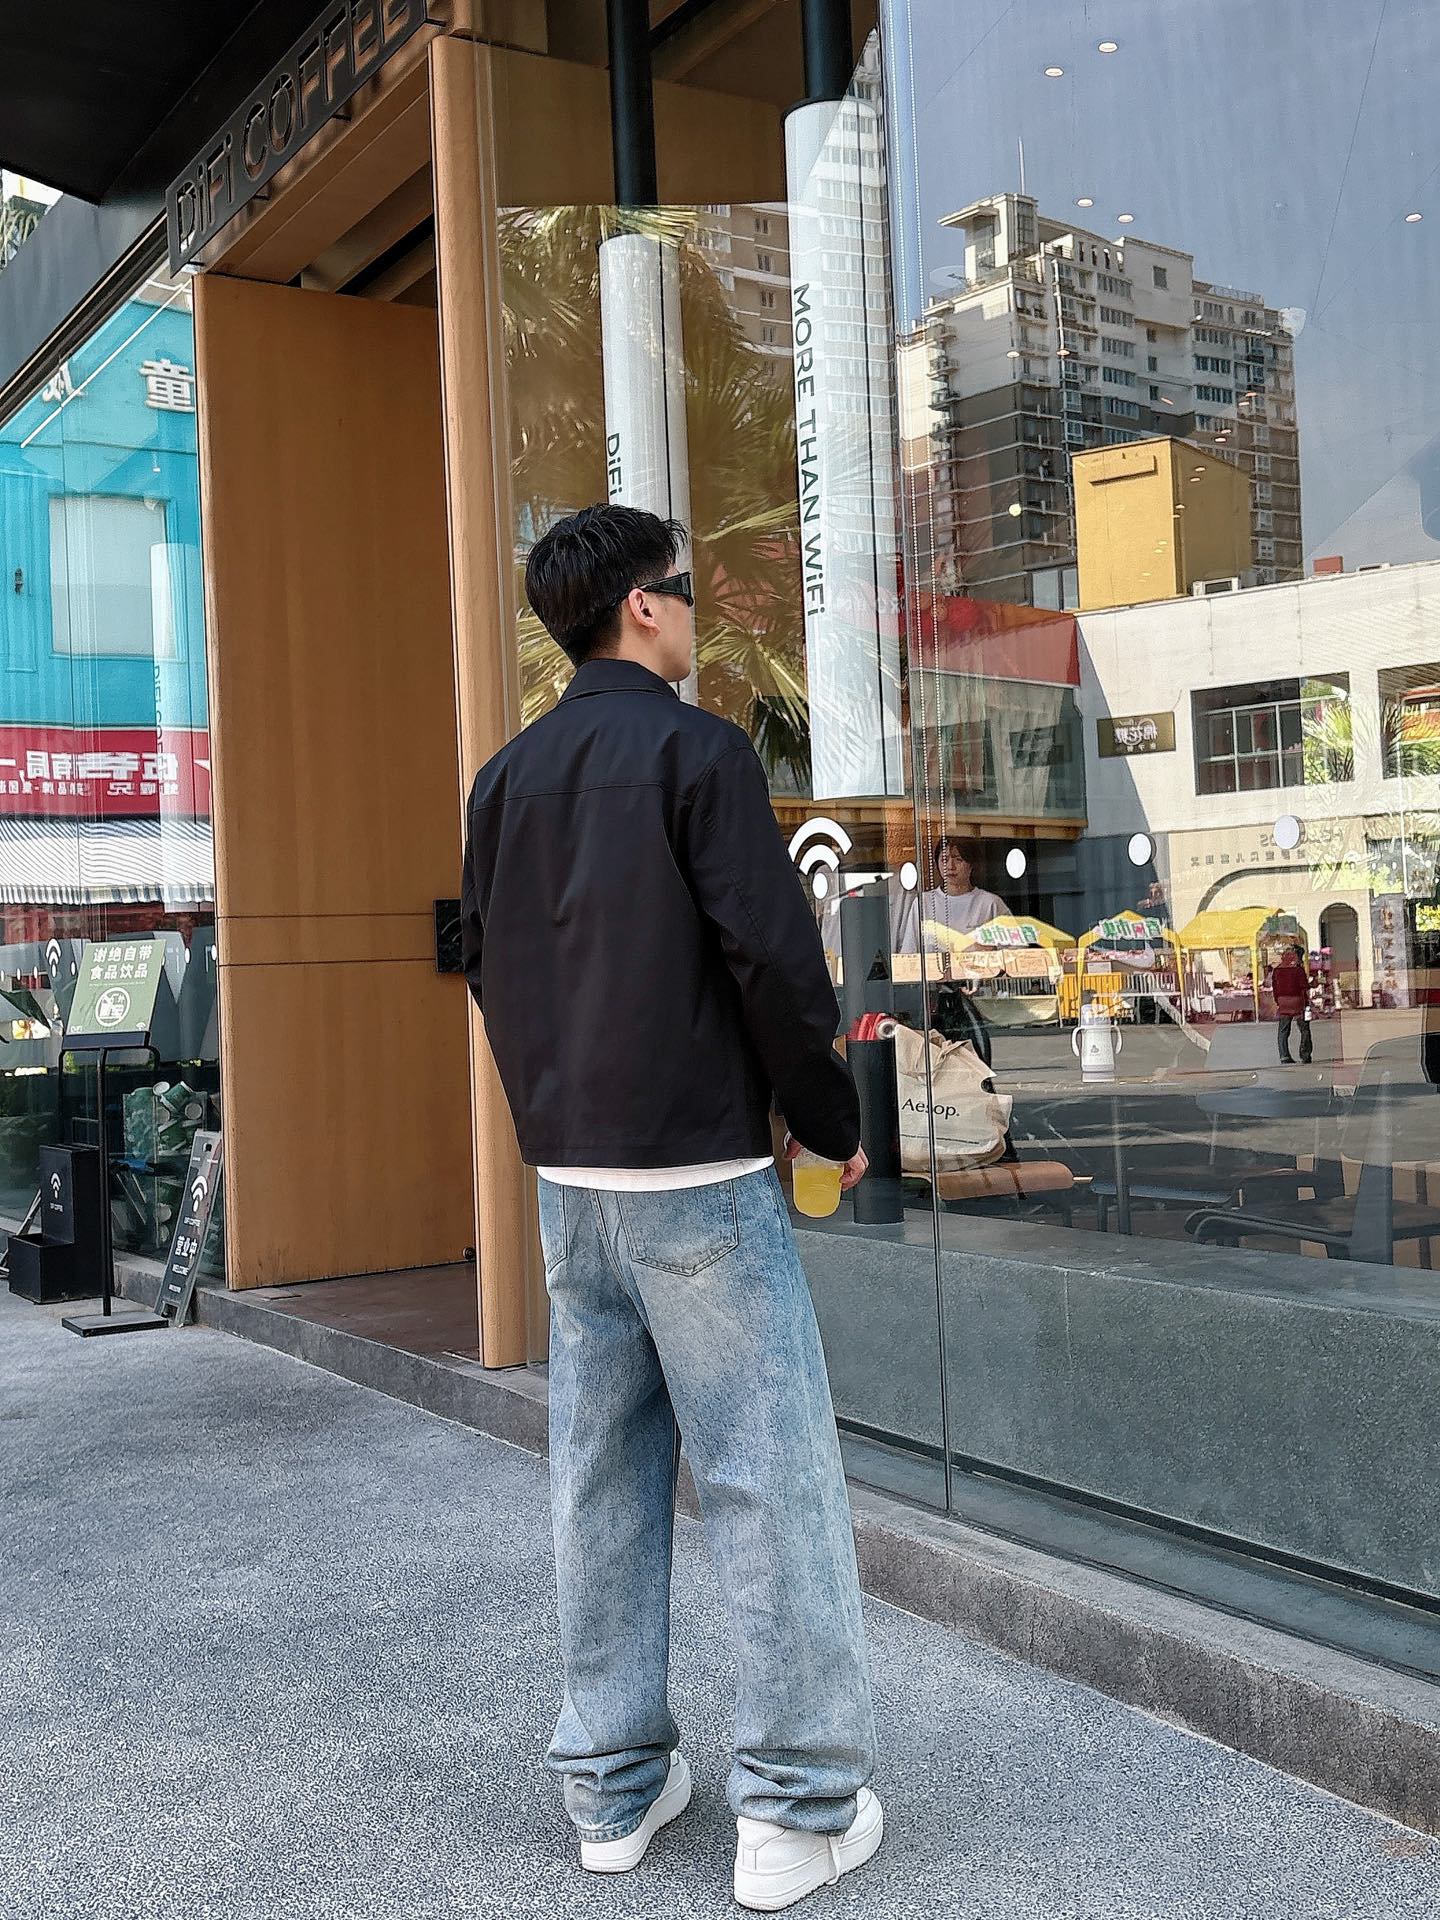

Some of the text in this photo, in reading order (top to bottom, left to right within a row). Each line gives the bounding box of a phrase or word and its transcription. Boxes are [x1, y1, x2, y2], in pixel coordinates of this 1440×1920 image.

[176, 0, 410, 254] DiFi COFFEE
[606, 432, 622, 497] DiFi
[793, 283, 825, 617] MORE THAN WiFi
[90, 963, 148, 981] 食品饮品
[93, 944, 153, 963] 谢绝自带
